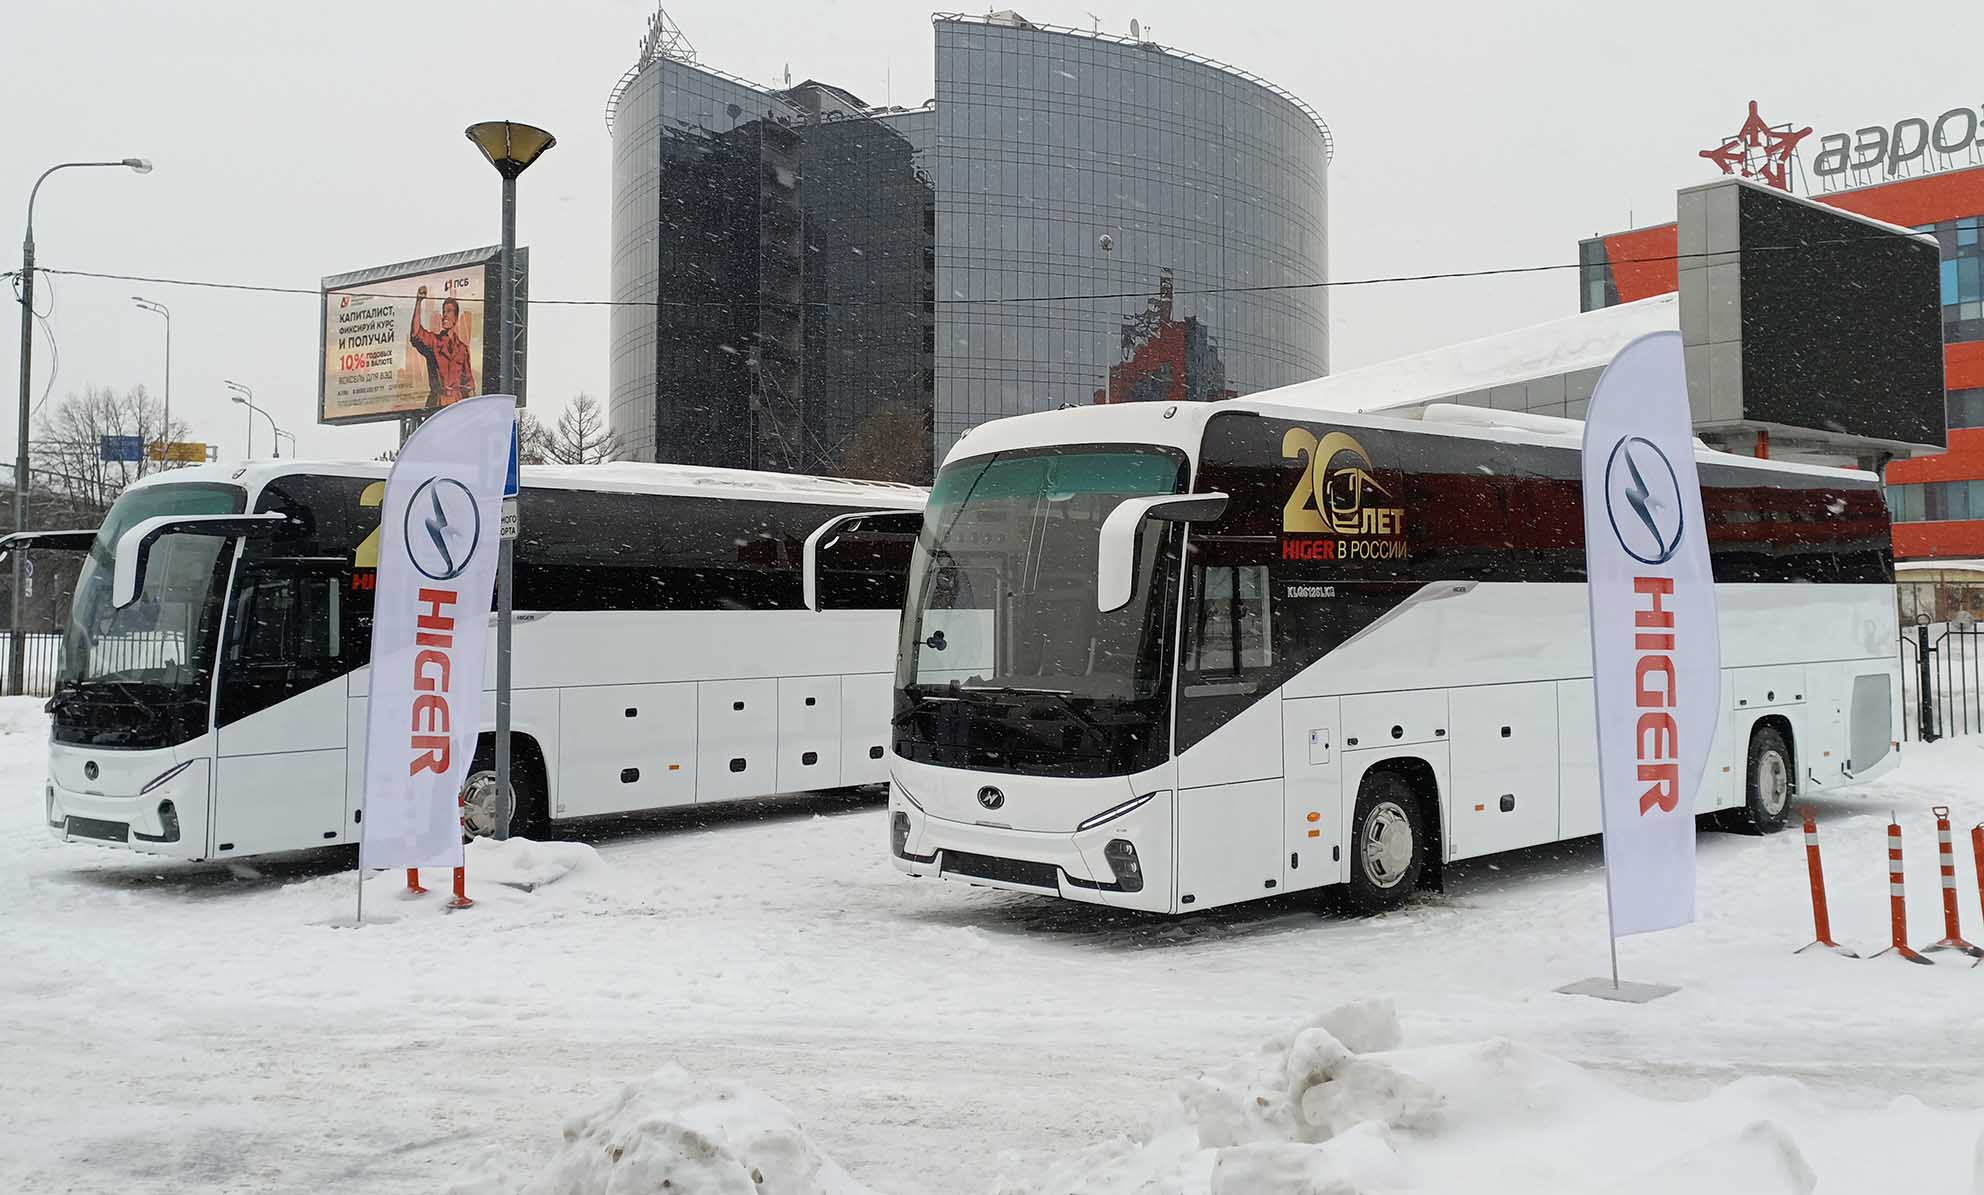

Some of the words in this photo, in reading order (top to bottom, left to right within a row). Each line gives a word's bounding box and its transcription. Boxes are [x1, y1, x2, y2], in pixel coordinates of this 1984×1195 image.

[1814, 104, 1984, 176] аэро
[453, 278, 470, 288] ПСБ
[339, 305, 395, 323] КАПИТАЛИСТ,
[338, 320, 376, 335] ФИКСИРУЙ
[377, 320, 394, 330] КУРС
[338, 338, 346, 350] И
[348, 328, 394, 348] ПОЛУЧАЙ
[339, 353, 365, 371] 10%
[355, 481, 385, 567] 2
[501, 526, 516, 536] ОРТА
[1361, 508, 1404, 534] ЛЕТ
[1282, 540, 1335, 560] HIGER
[1338, 540, 1347, 559] В
[1351, 540, 1407, 559] РОССИИ
[410, 588, 457, 776] HIGER
[1634, 577, 1679, 816] HIGER
